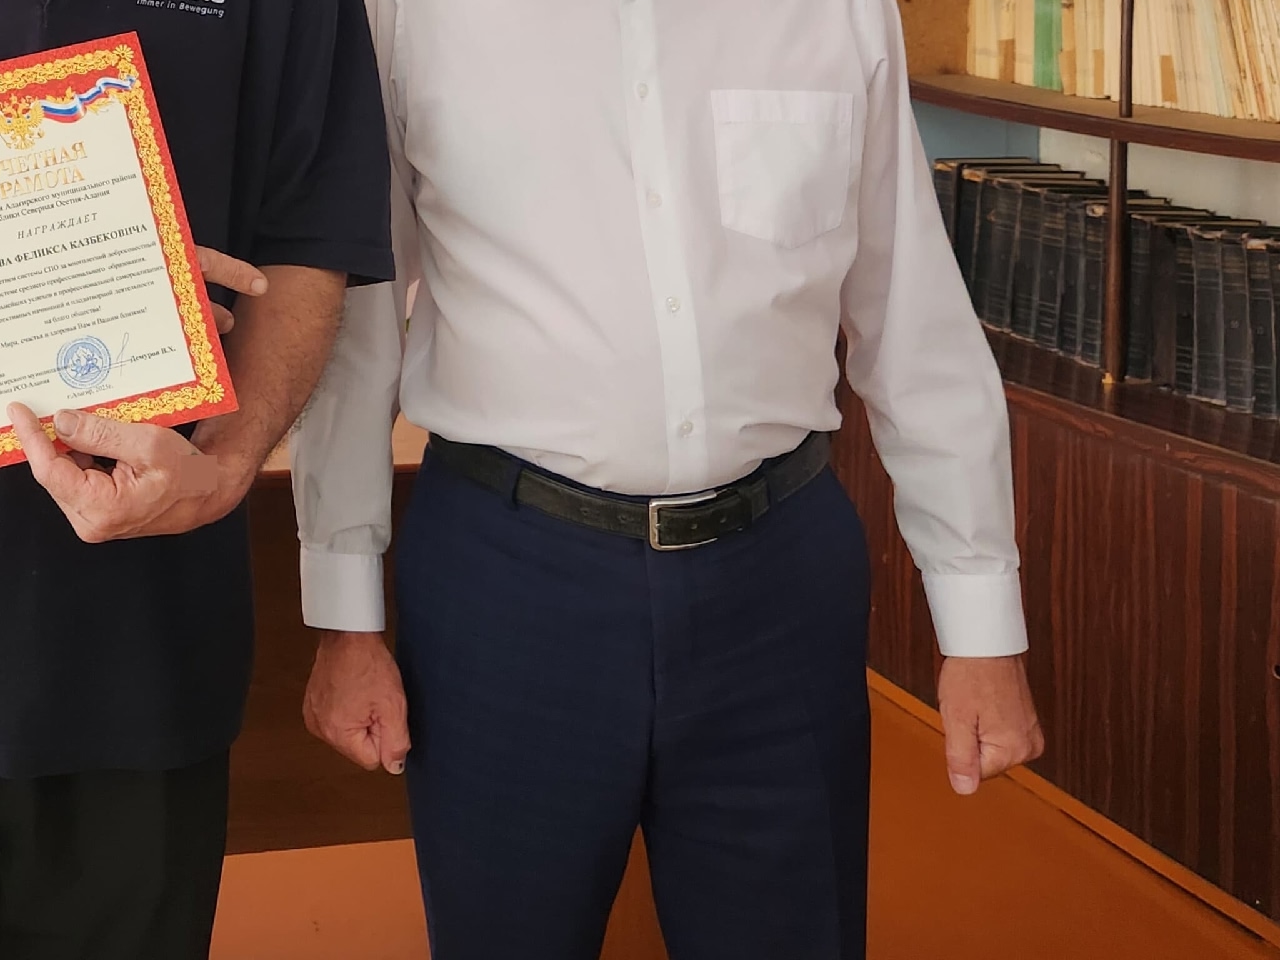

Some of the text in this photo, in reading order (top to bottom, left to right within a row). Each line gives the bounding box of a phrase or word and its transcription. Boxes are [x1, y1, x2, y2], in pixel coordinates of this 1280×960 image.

[167, 1, 176, 9] in
[179, 2, 225, 18] Bewegung
[6, 195, 50, 209] Алагирского
[51, 180, 110, 198] муниципального
[111, 173, 137, 184] района
[21, 203, 55, 215] Северная
[56, 190, 110, 206] Осетия-Алания
[18, 213, 97, 238] НАГРАЖДАЕТ
[14, 244, 68, 262] ФЕЛИКСА
[70, 224, 147, 248] КАЗБЕКОВИЧА
[17, 270, 43, 279] системы
[43, 264, 59, 273] СПО
